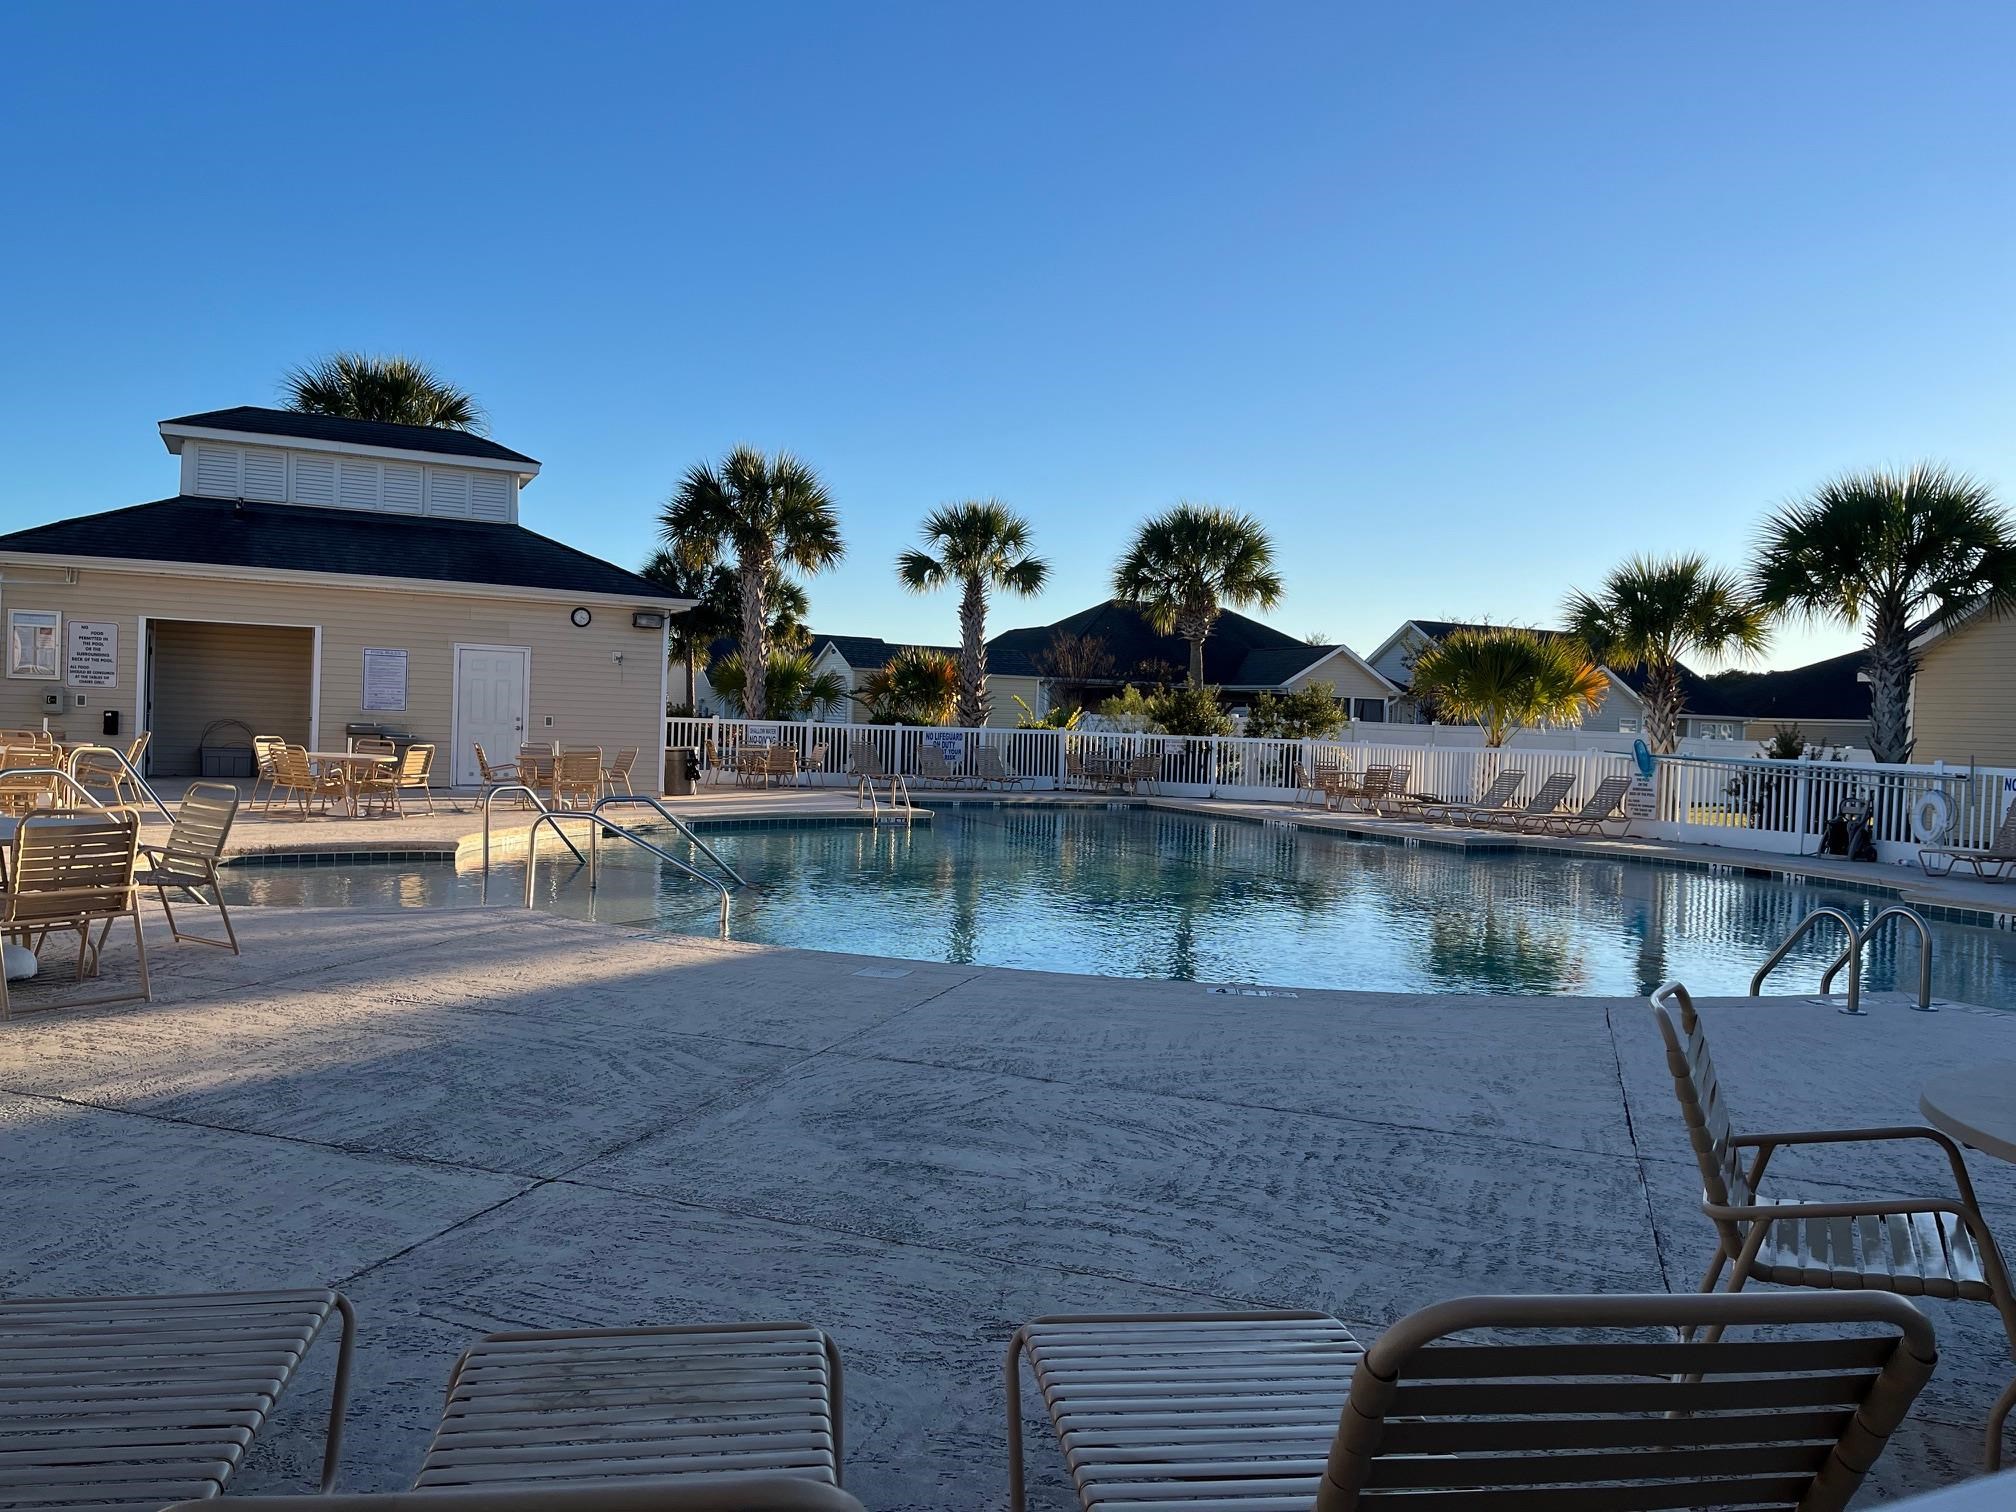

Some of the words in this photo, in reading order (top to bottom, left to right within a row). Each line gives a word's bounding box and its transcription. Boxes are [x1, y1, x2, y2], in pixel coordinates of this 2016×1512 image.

[926, 732, 934, 741] NO
[934, 732, 963, 741] LIFEGUARD
[942, 741, 956, 749] DUTY
